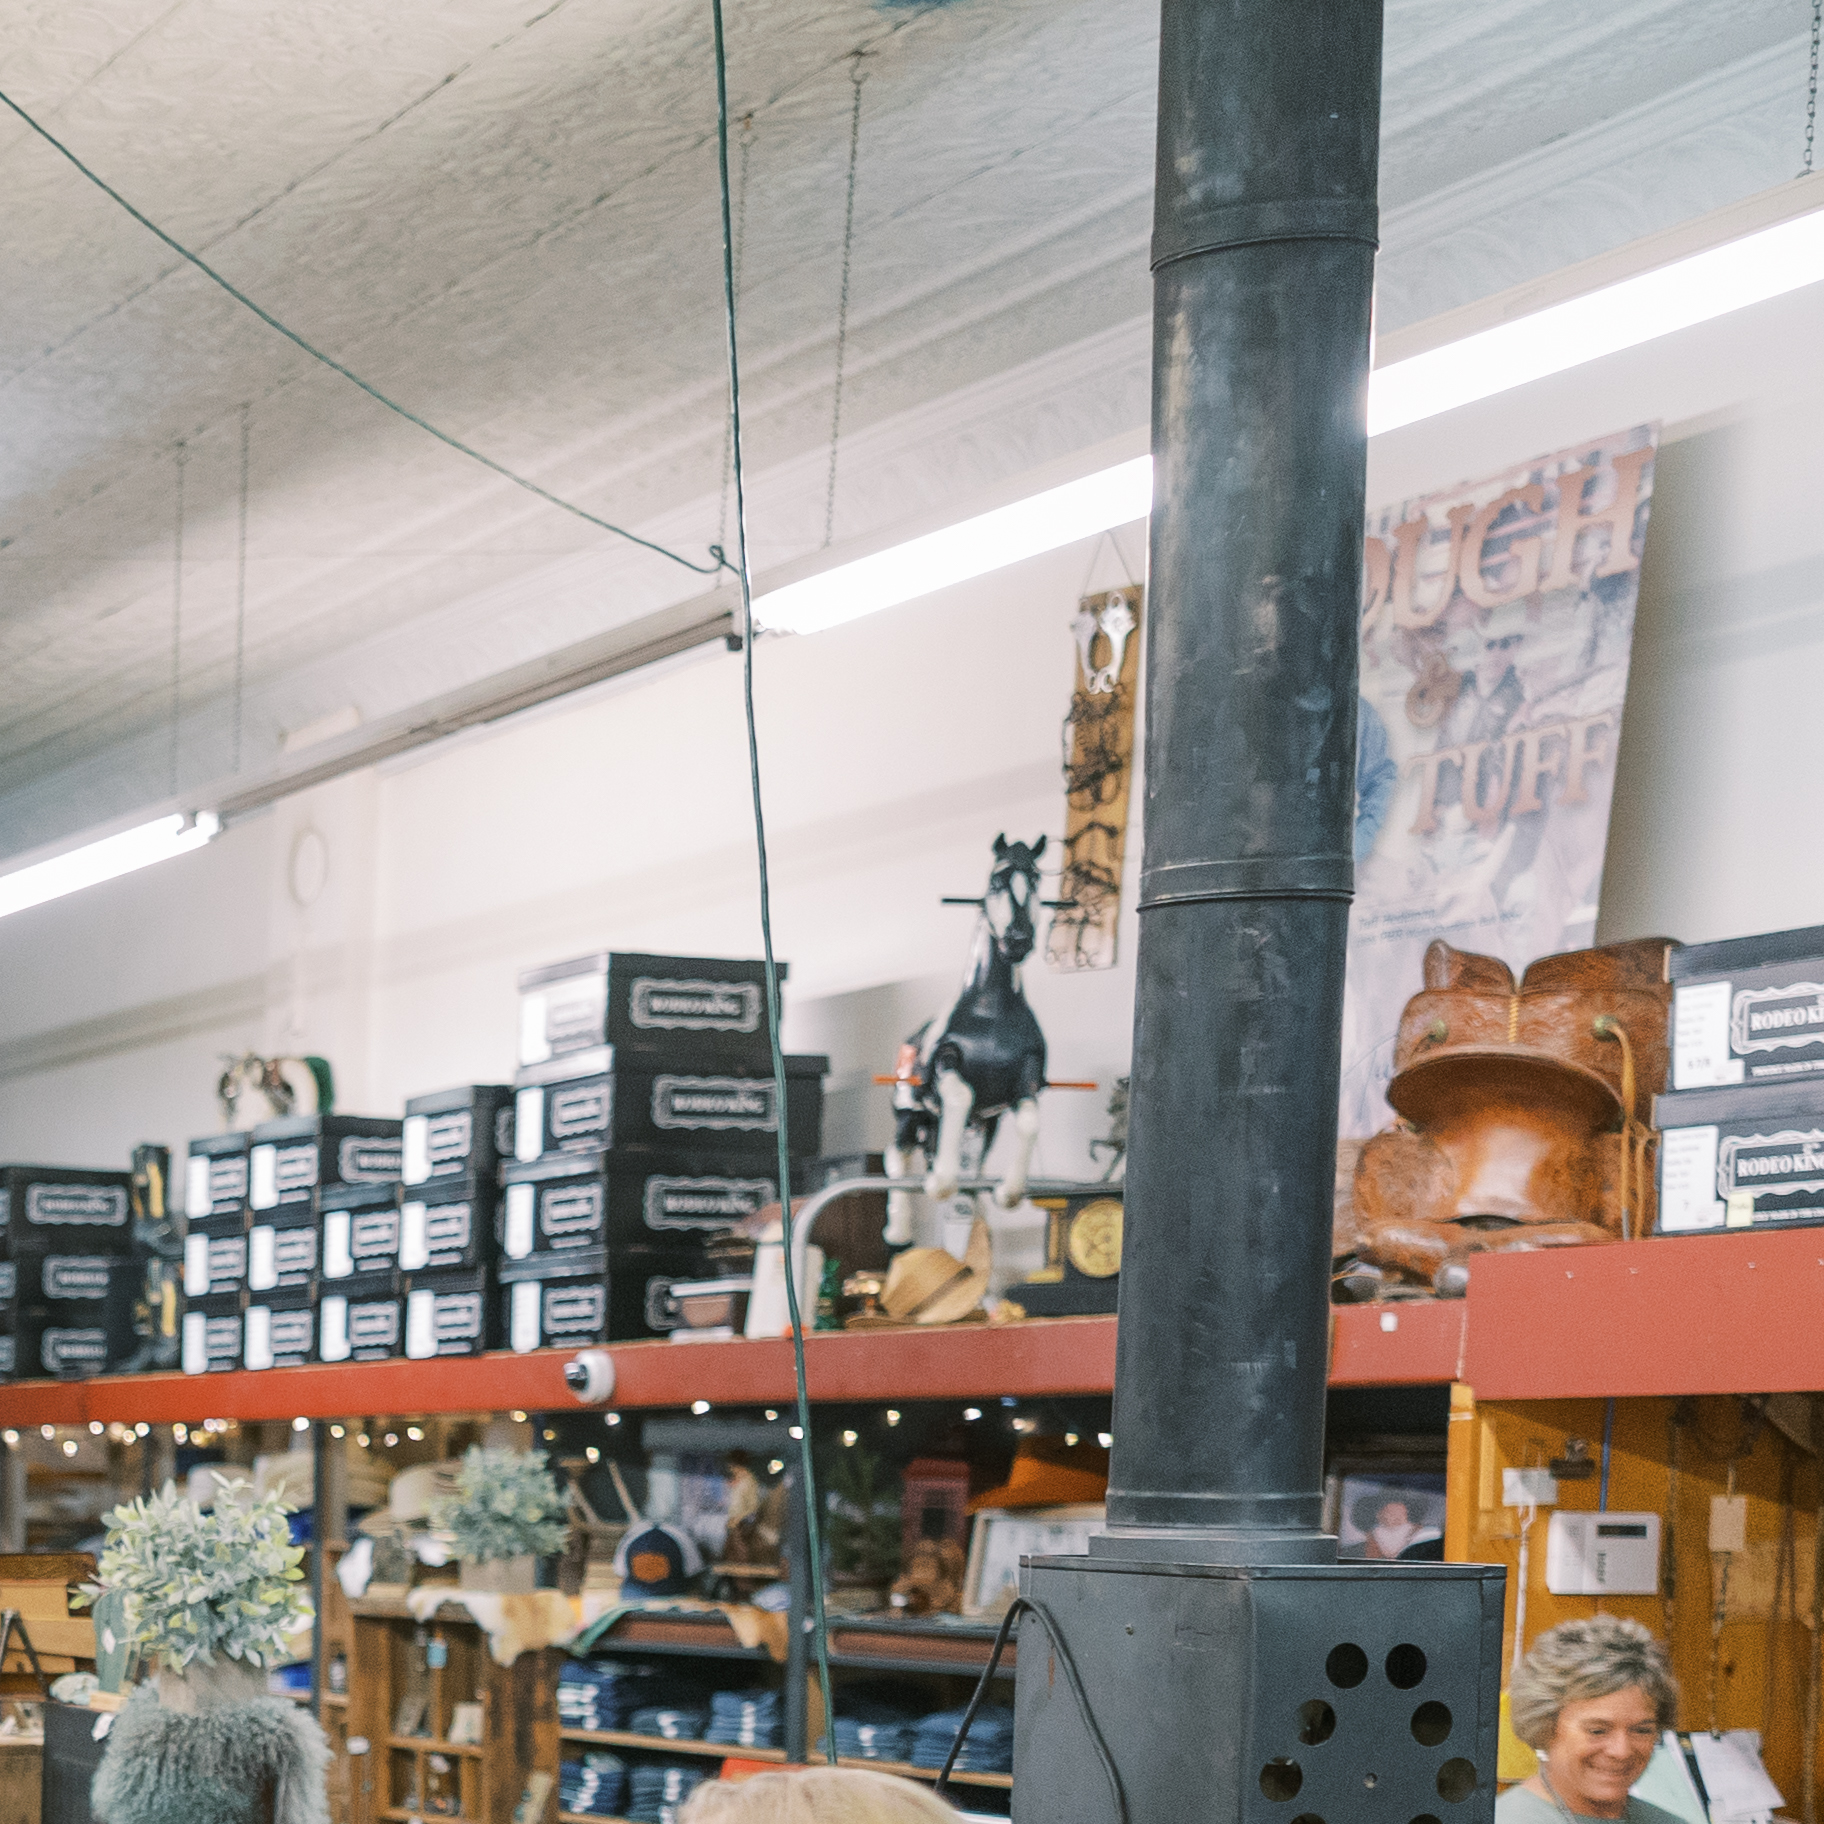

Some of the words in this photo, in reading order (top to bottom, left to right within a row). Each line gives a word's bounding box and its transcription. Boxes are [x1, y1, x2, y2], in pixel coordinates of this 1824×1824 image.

[1358, 448, 1653, 630] UGH
[1405, 712, 1612, 835] TUFF
[1751, 1008, 1807, 1031] RODEO
[1807, 1005, 1824, 1024] KI
[1737, 1155, 1792, 1178] RODEO
